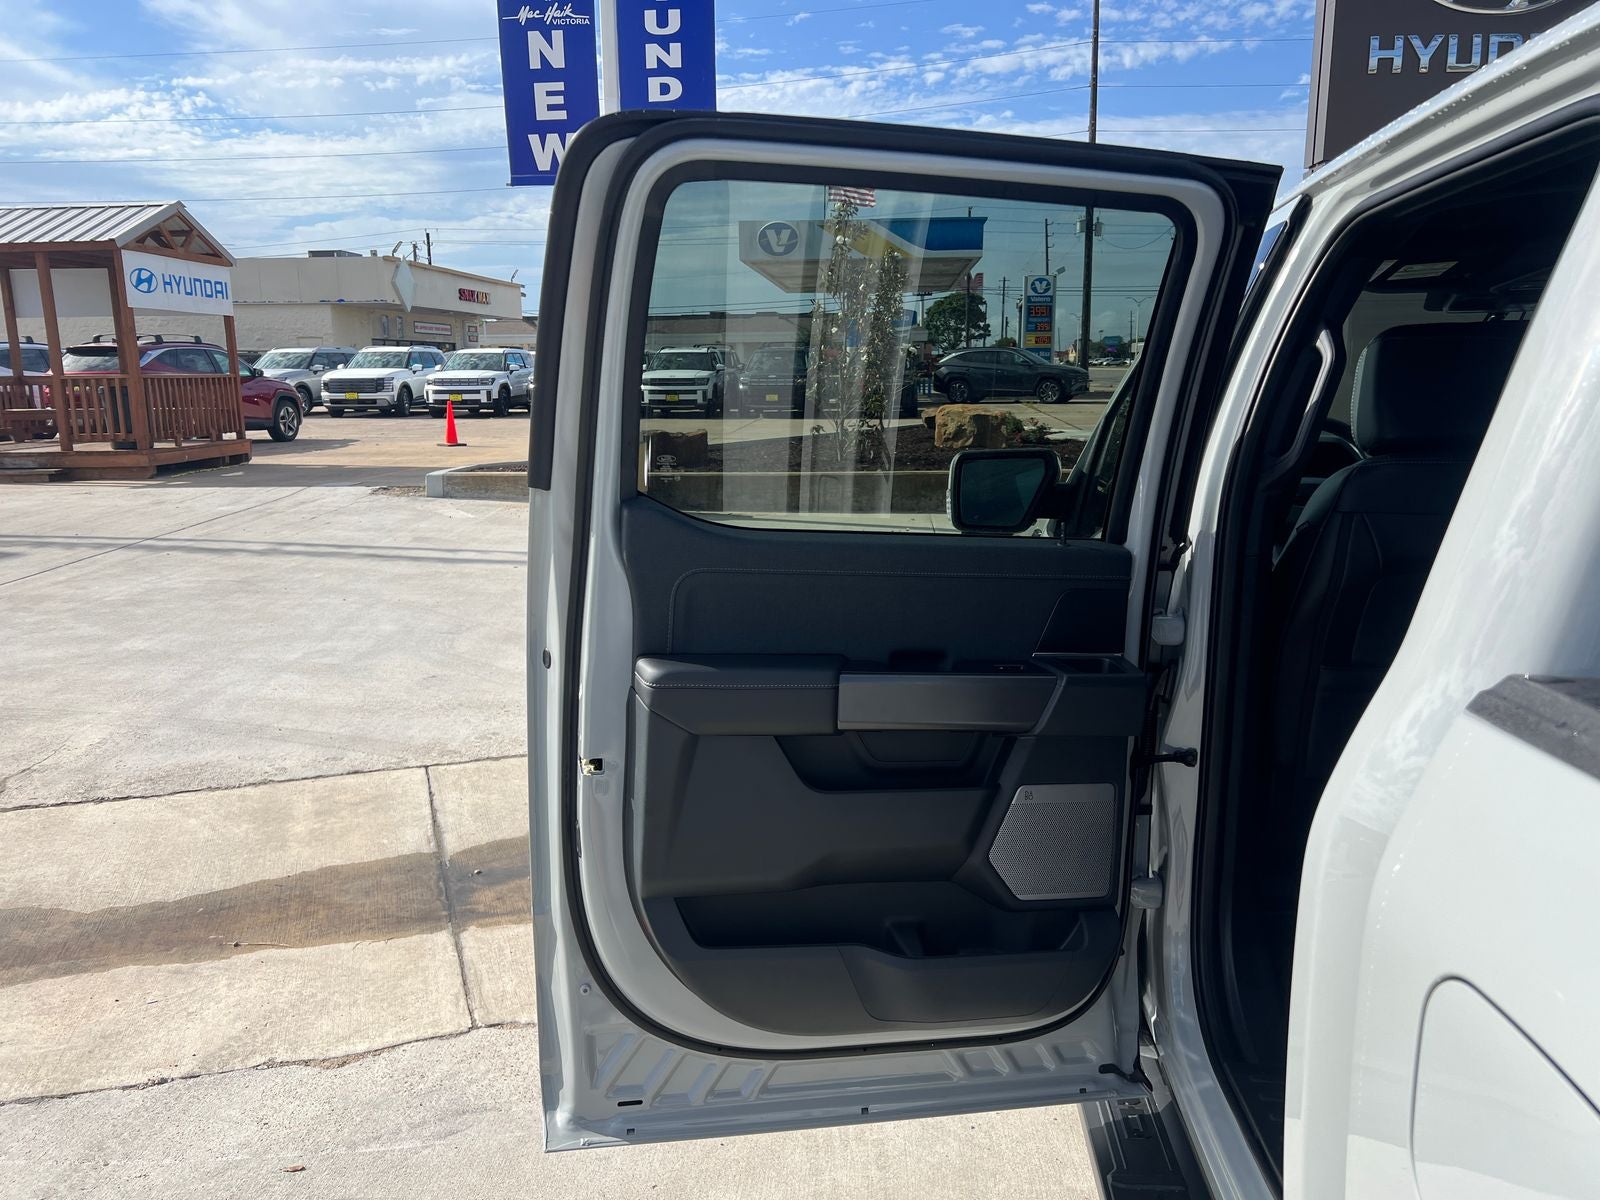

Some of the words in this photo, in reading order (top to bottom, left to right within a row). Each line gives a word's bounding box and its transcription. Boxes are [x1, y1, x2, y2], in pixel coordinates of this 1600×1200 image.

[517, 5, 541, 25] Mac
[544, 3, 573, 25] Haik
[162, 273, 229, 300] HYUNDAI
